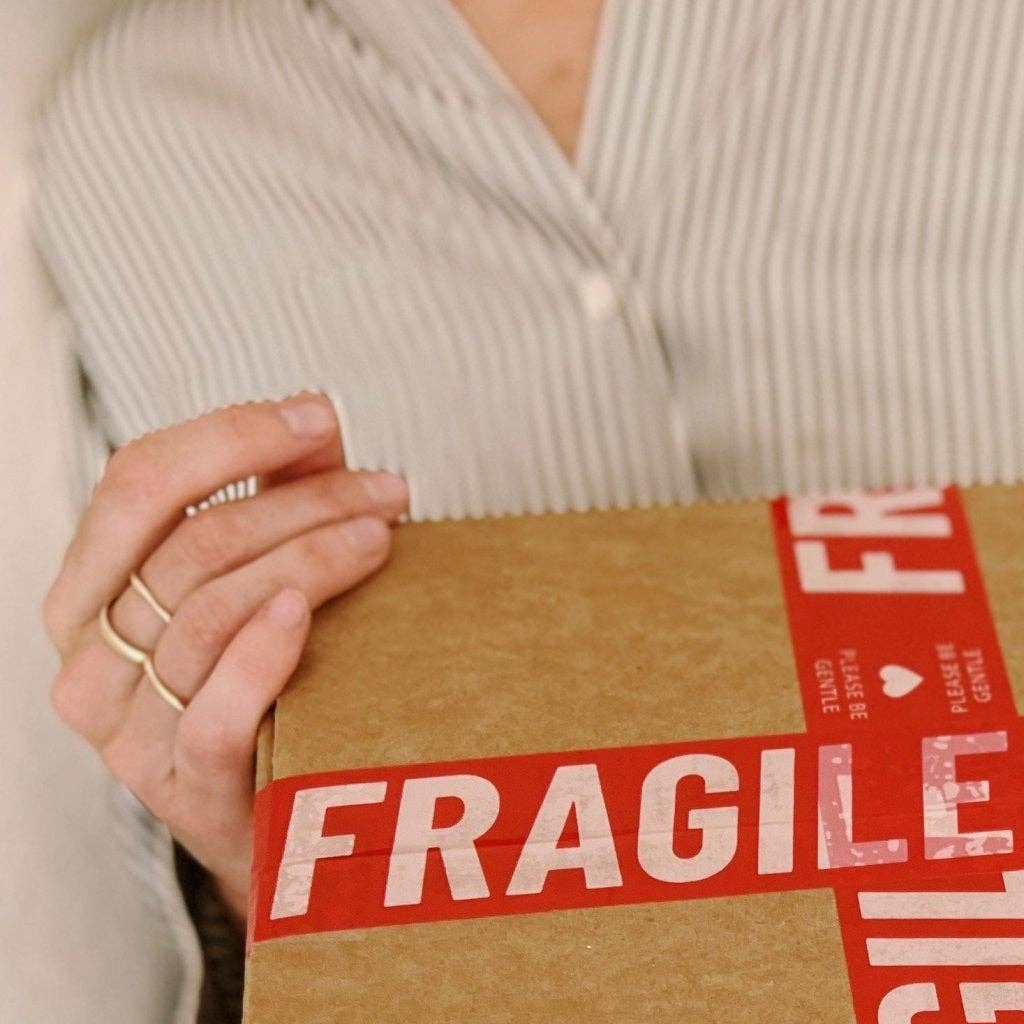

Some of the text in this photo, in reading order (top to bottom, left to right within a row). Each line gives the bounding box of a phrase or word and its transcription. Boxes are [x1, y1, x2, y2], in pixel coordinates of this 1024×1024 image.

[814, 659, 840, 713] GENTLE
[839, 648, 868, 720] PLEASE BE
[936, 643, 968, 713] PLEASE BE
[962, 649, 992, 702] GENTLE
[270, 731, 1014, 920] FRAGILE
